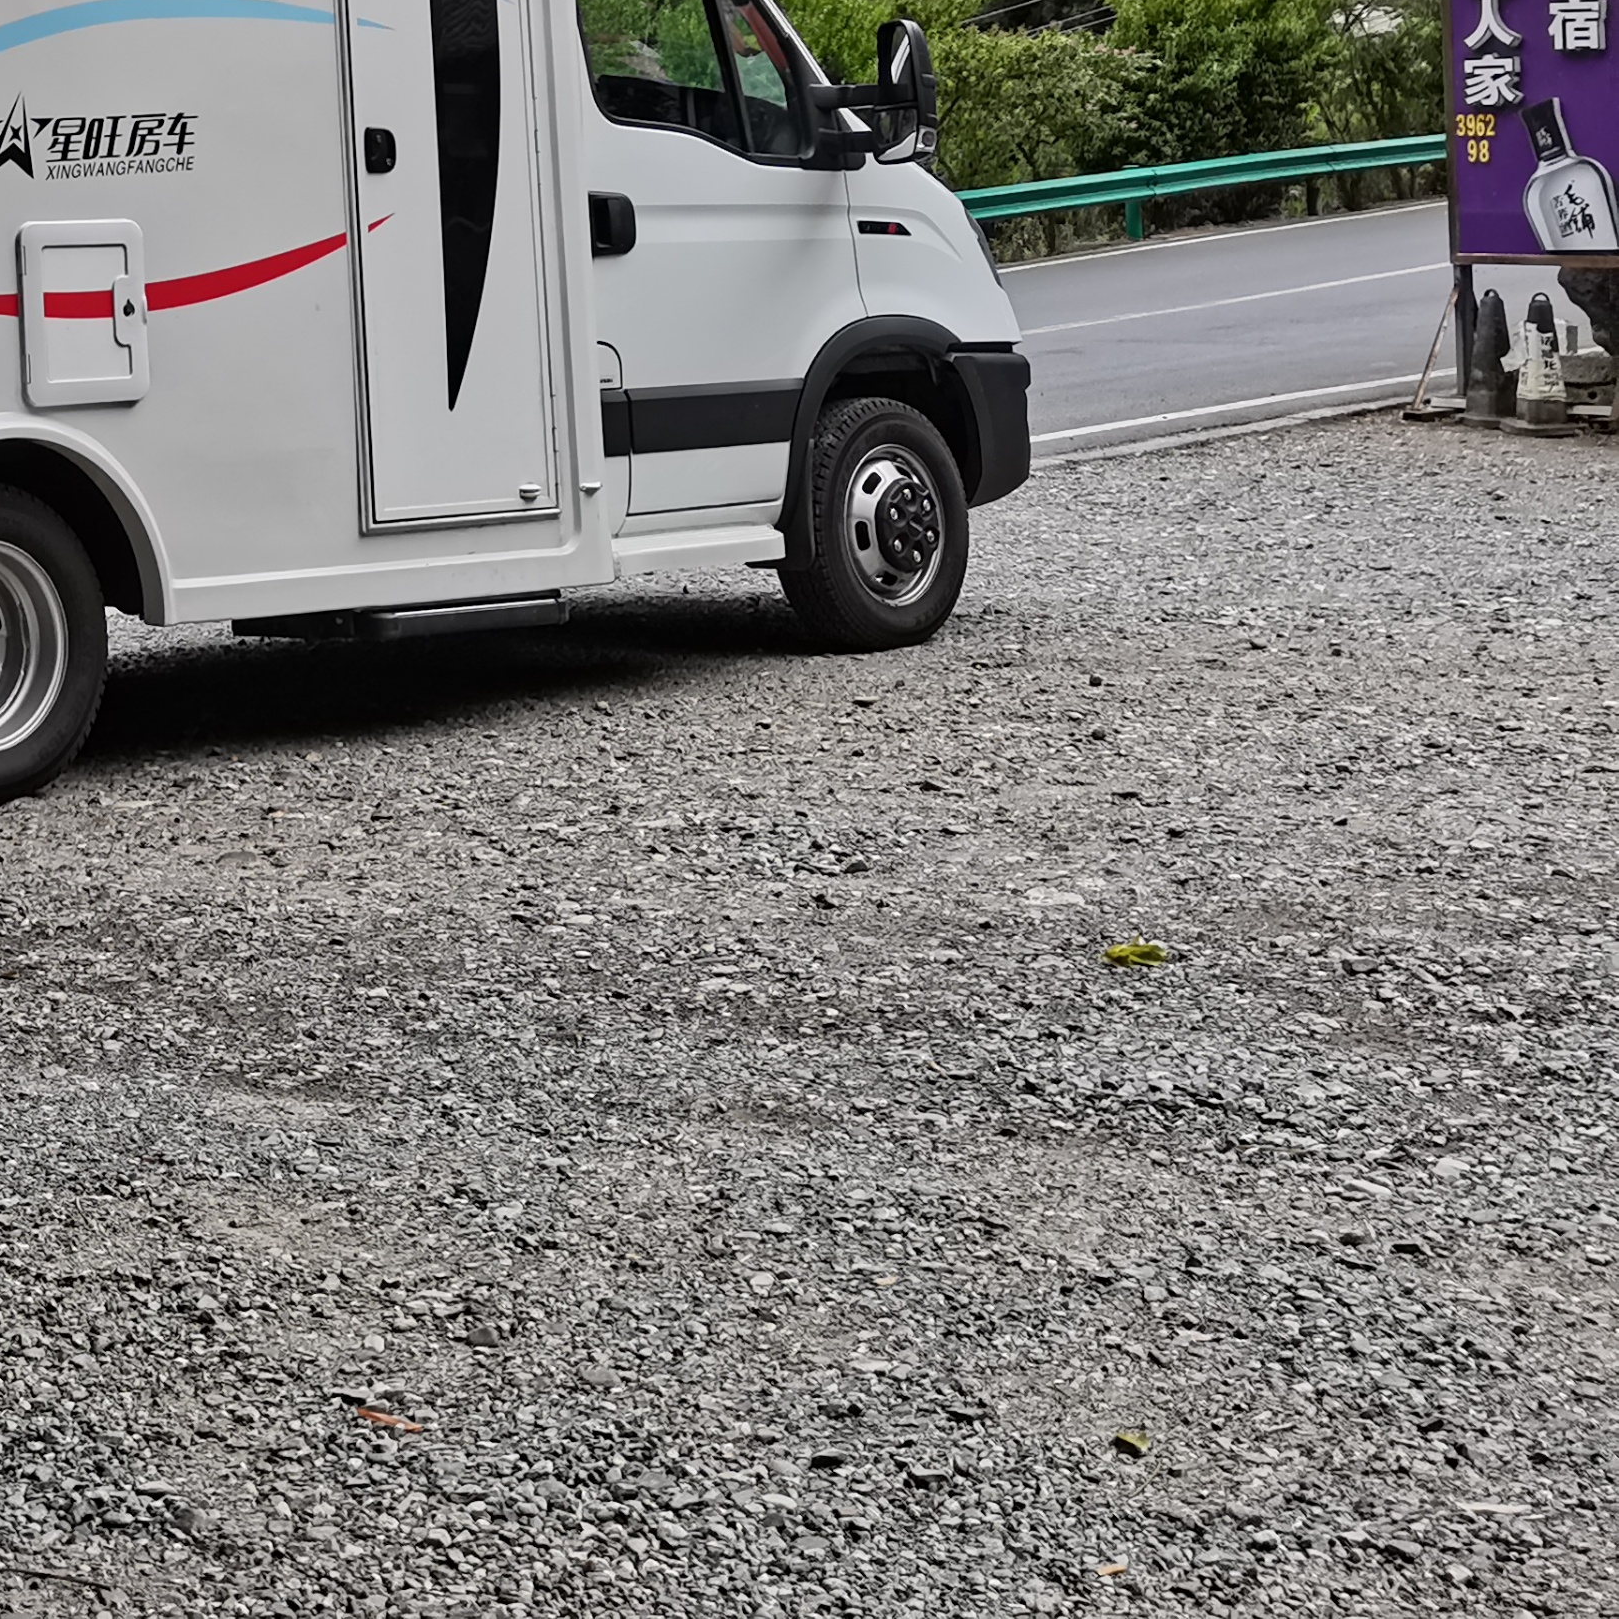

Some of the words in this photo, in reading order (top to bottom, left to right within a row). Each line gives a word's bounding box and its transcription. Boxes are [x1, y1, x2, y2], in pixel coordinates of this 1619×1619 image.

[46, 112, 199, 163] 星旺房车
[1456, 113, 1496, 137] 3962
[1467, 139, 1490, 163] 98
[45, 156, 195, 181] XINGWANGFANGCHE
[1563, 183, 1595, 239] 毛铺
